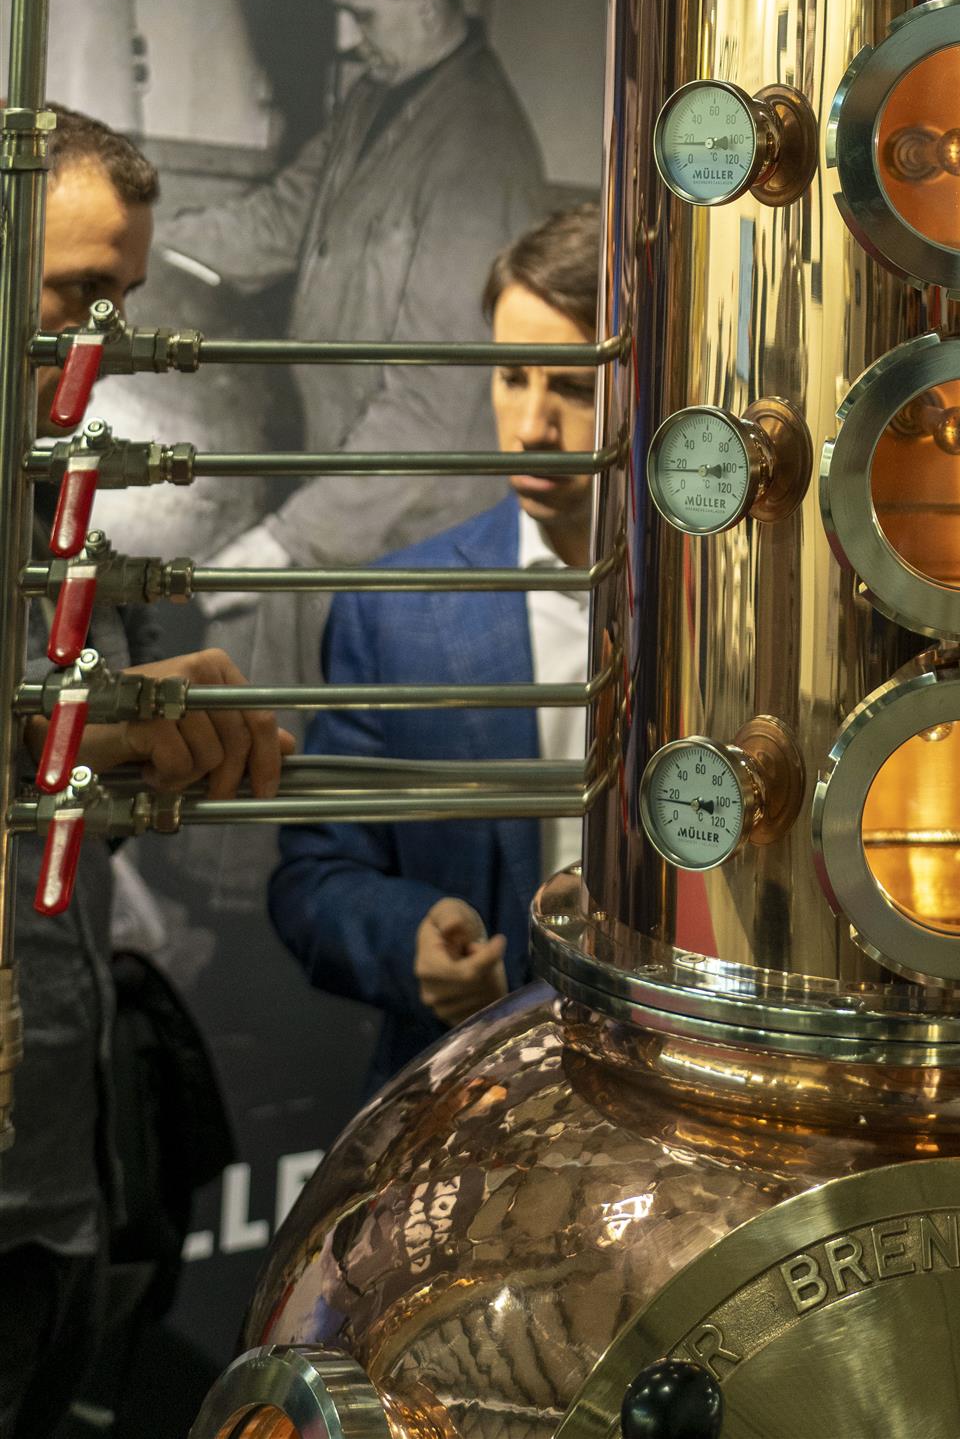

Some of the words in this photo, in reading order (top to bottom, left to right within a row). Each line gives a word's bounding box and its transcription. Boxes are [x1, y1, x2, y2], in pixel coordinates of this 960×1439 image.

[709, 106, 720, 116] 60
[726, 115, 736, 125] 80
[730, 134, 744, 145] 100
[725, 154, 739, 165] 120
[692, 168, 734, 180] MÜLLER
[702, 432, 713, 443] 60
[684, 440, 695, 450] 40
[676, 459, 687, 469] 20
[722, 463, 737, 473] 100
[718, 482, 732, 494] 120
[685, 494, 726, 509] MÜLLER
[695, 763, 706, 775] 60
[677, 770, 688, 781] 40
[712, 775, 723, 786] 80
[669, 788, 680, 800] 20
[716, 795, 730, 808] 100
[711, 816, 726, 828] 120
[678, 826, 720, 843] MÜLLER
